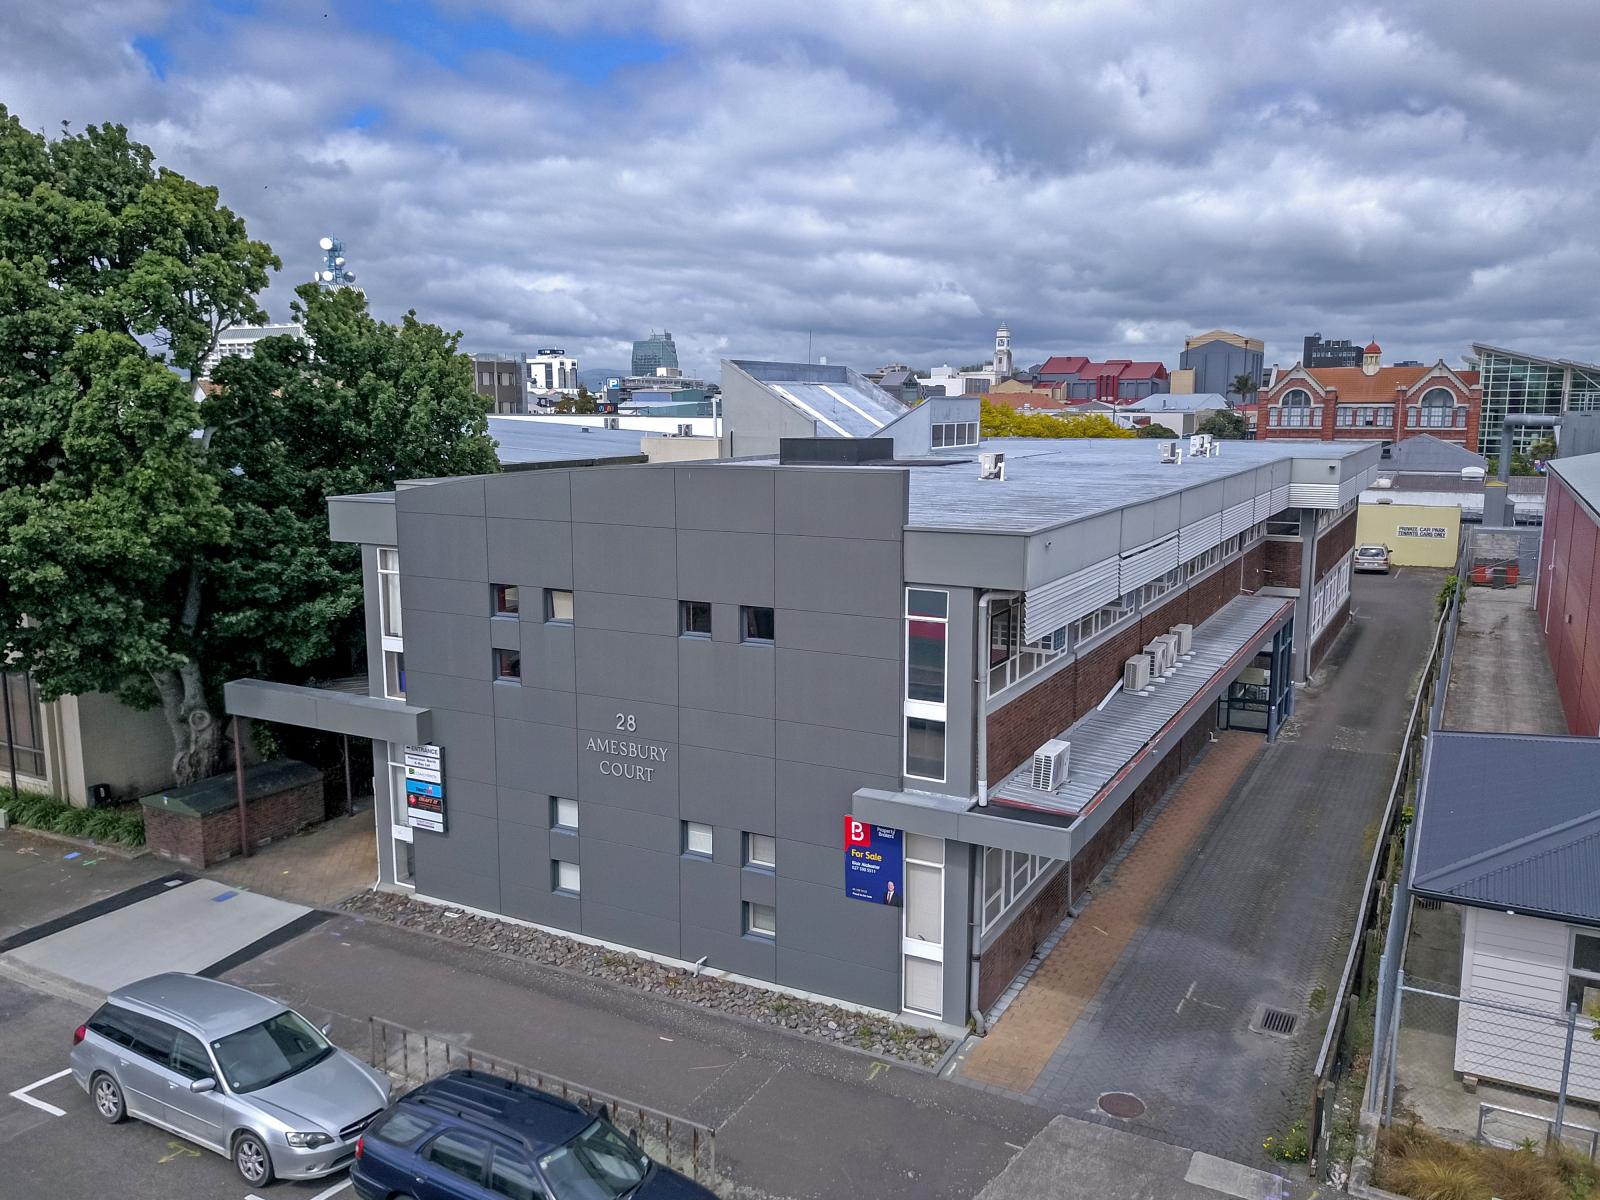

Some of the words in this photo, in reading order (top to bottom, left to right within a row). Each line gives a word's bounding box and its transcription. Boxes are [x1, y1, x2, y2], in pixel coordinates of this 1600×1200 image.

[615, 712, 637, 732] 28
[411, 745, 439, 756] ENTRANCE
[586, 737, 668, 762] AMESBURY
[599, 760, 655, 782] COURT
[851, 848, 864, 858] For
[865, 851, 882, 861] Sale
